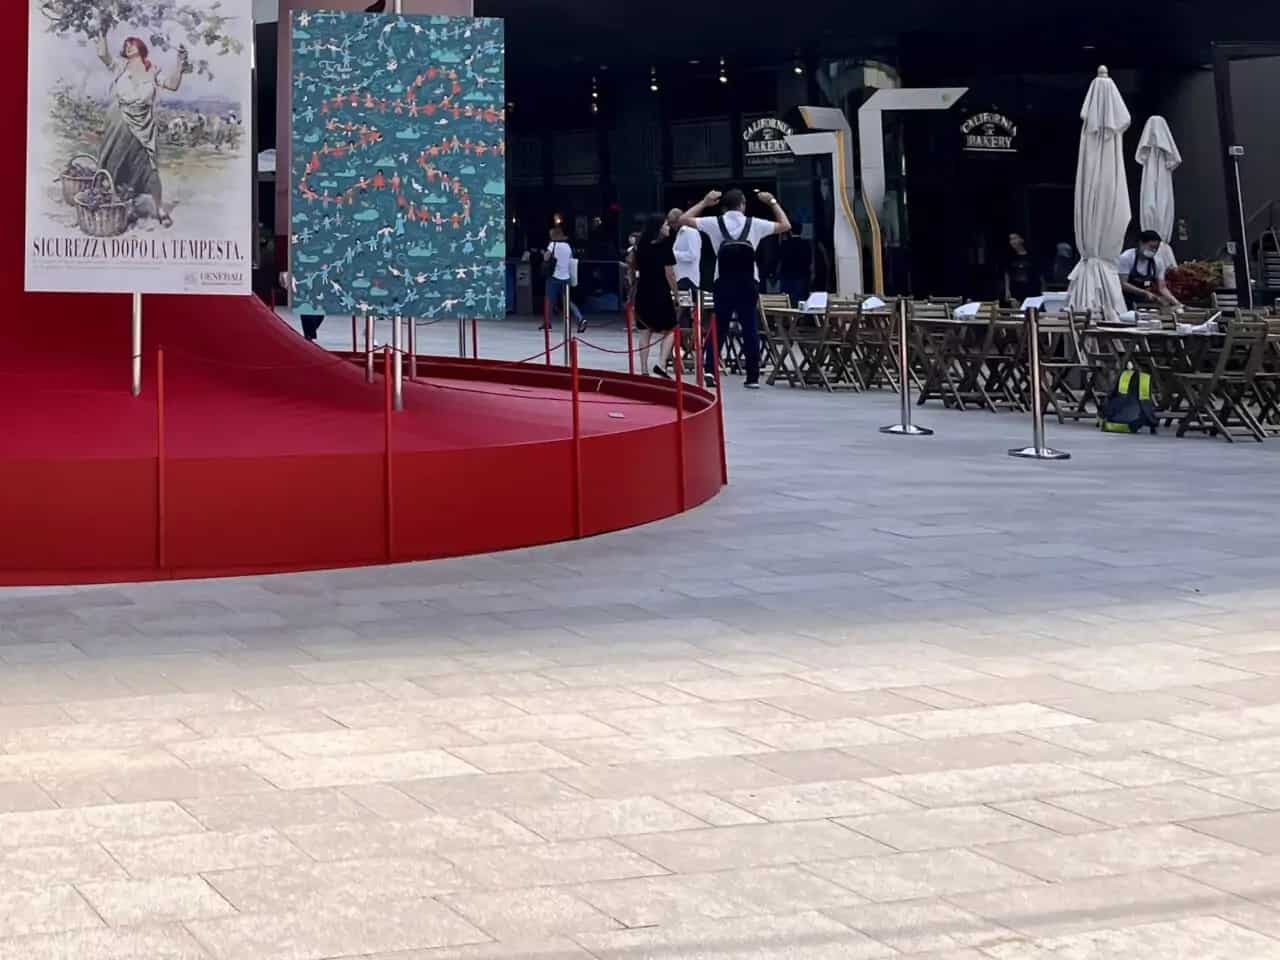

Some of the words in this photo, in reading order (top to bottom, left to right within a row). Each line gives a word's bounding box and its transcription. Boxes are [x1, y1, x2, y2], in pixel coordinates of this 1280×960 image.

[962, 112, 1017, 136] CALIFORNIA
[966, 135, 1012, 148] BAKERY
[33, 238, 107, 258] SICUREZZA
[111, 239, 148, 258] DOPO
[151, 239, 168, 259] LA
[170, 239, 244, 260] TEMPESTA.
